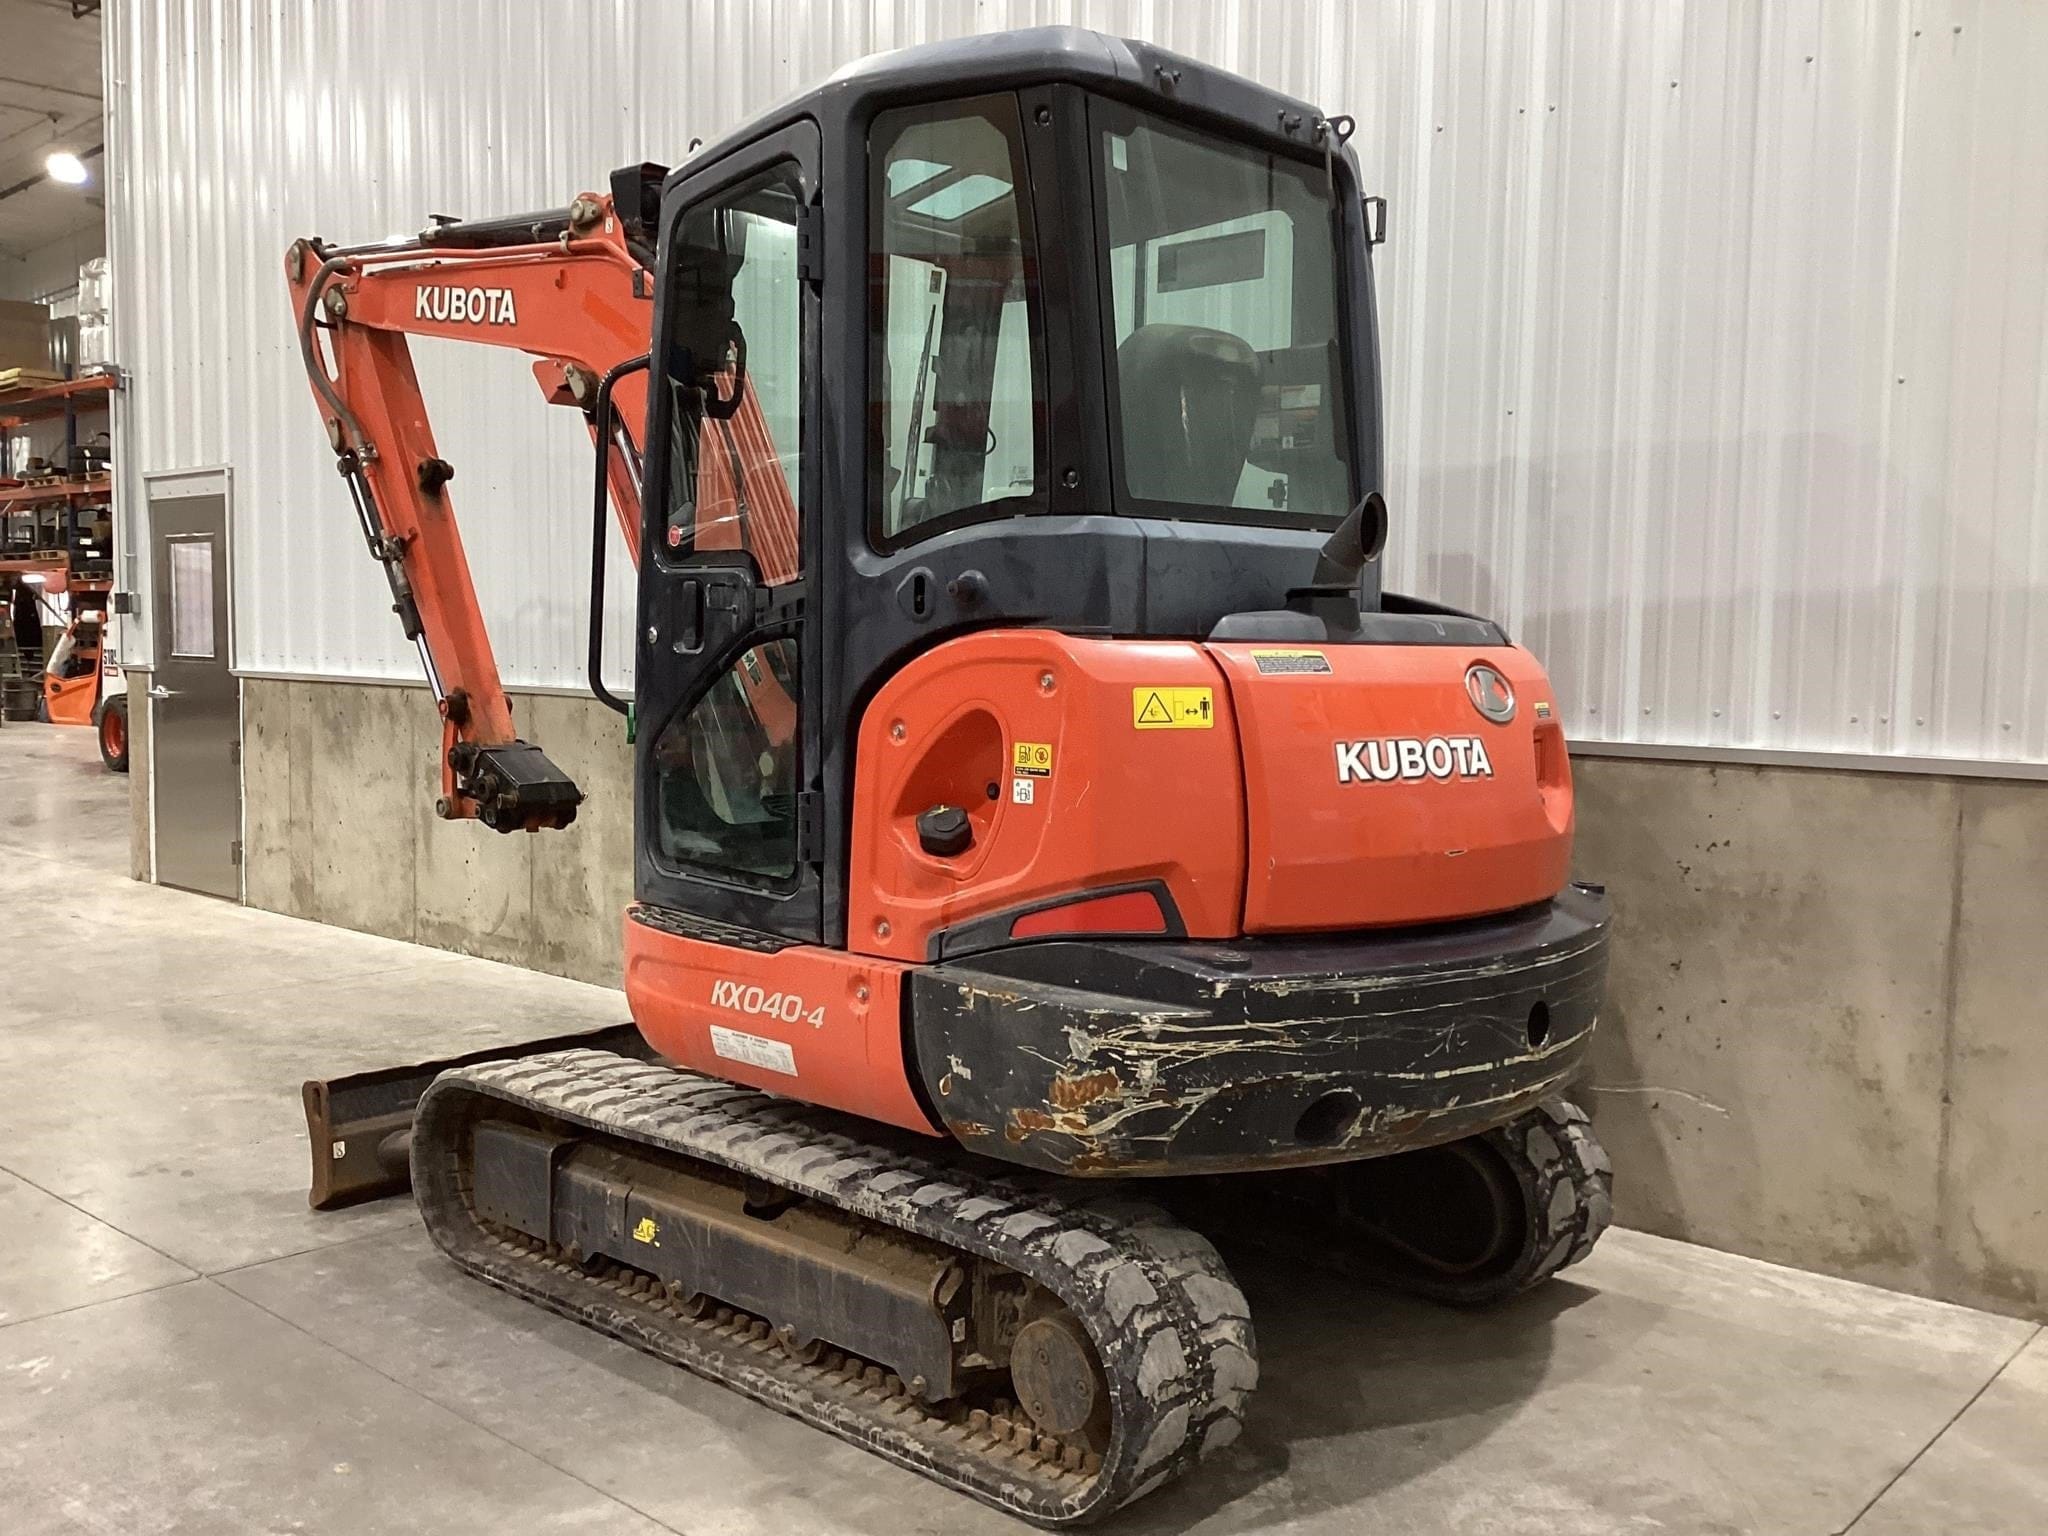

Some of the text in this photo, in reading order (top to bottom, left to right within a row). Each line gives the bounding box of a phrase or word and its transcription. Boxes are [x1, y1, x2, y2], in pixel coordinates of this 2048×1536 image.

[415, 285, 517, 325] KUBOTA
[1335, 737, 1494, 783] KUBOTA
[710, 979, 825, 1029] KX040-4
